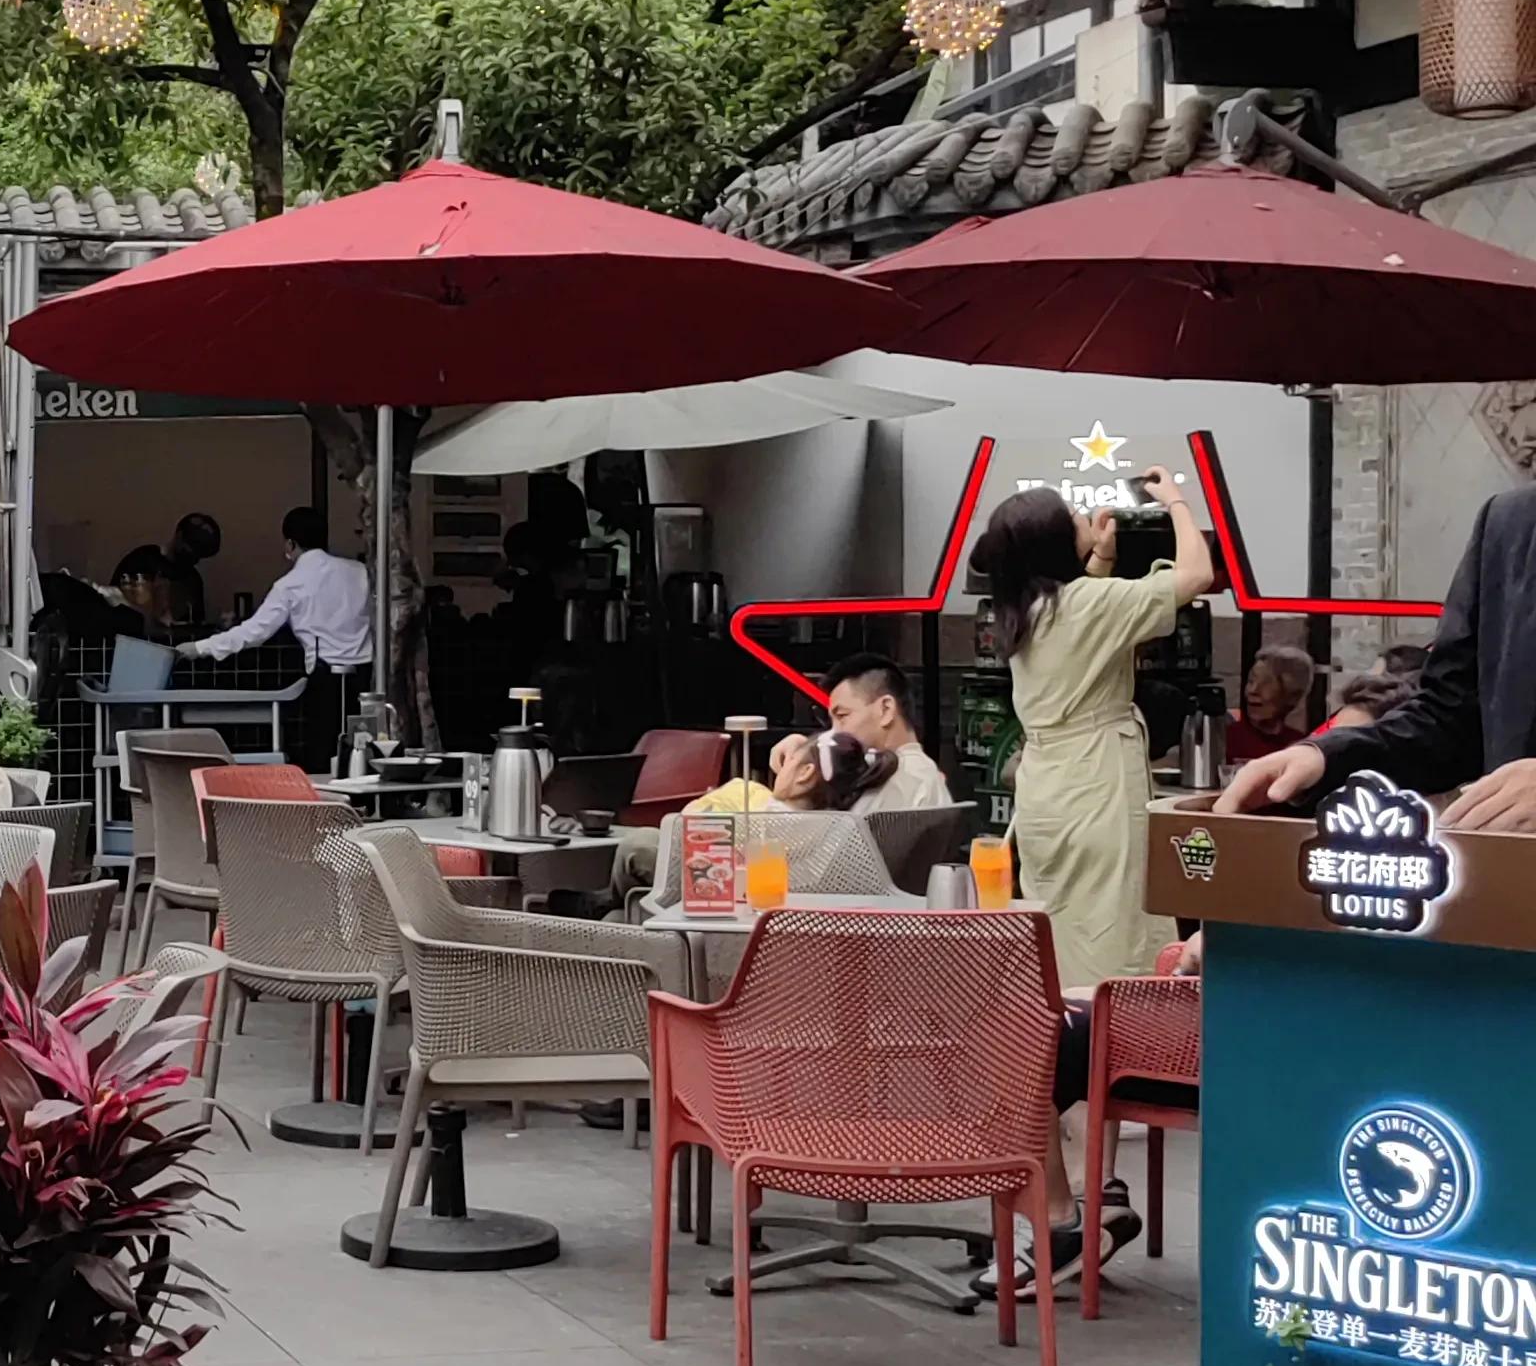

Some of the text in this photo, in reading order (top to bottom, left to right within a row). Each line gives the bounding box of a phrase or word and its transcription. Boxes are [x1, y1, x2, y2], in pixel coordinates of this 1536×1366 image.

[465, 780, 478, 799] 09
[1308, 848, 1431, 890] 莲花府邸
[1331, 893, 1407, 920] LOTUS
[1353, 1118, 1446, 1159] THE SINGLETON
[1346, 1168, 1452, 1232] PERFECTLY BALANCED
[1299, 1212, 1338, 1236] THE
